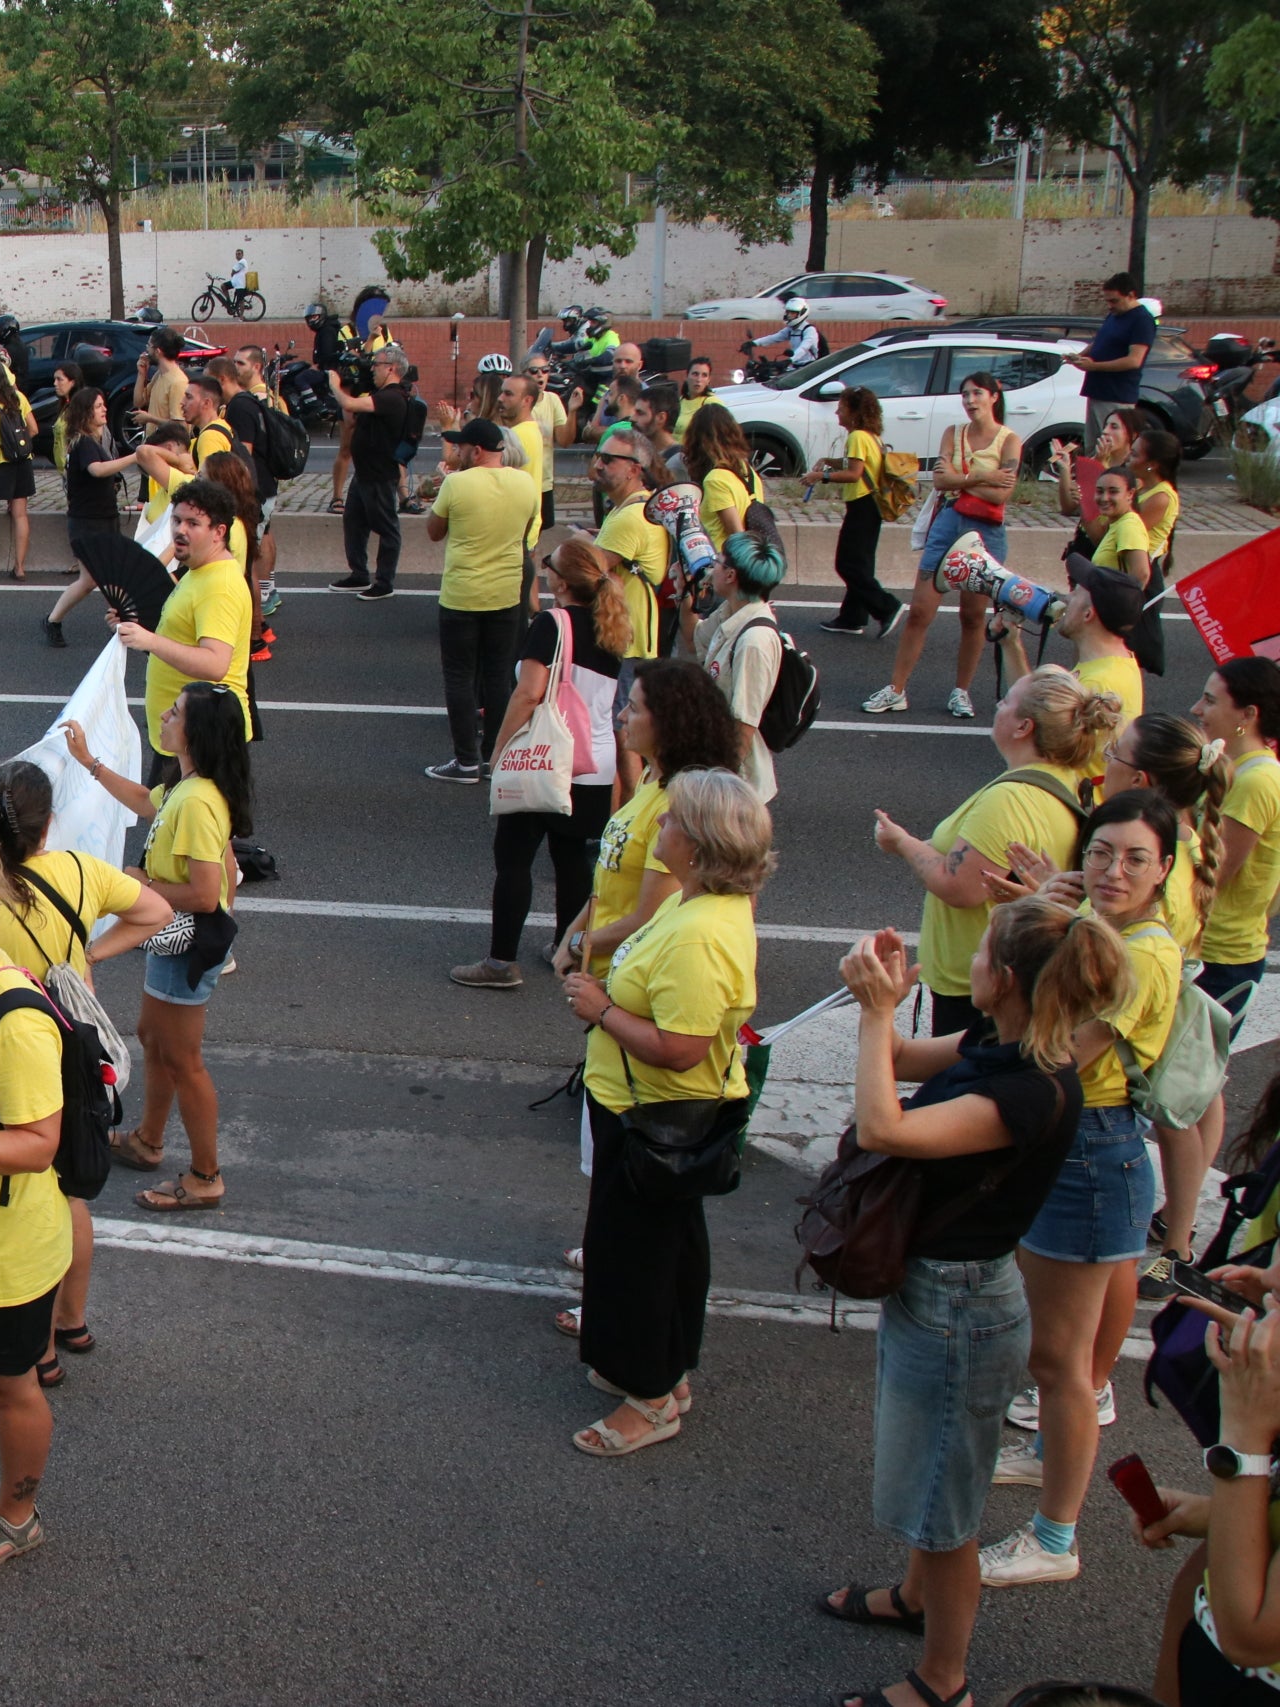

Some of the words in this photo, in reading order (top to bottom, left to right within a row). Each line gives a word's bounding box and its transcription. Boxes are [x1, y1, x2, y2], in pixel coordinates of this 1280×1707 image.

[1183, 586, 1236, 662] Sindicat
[504, 747, 532, 760] INTER
[501, 759, 555, 771] SINDICAL
